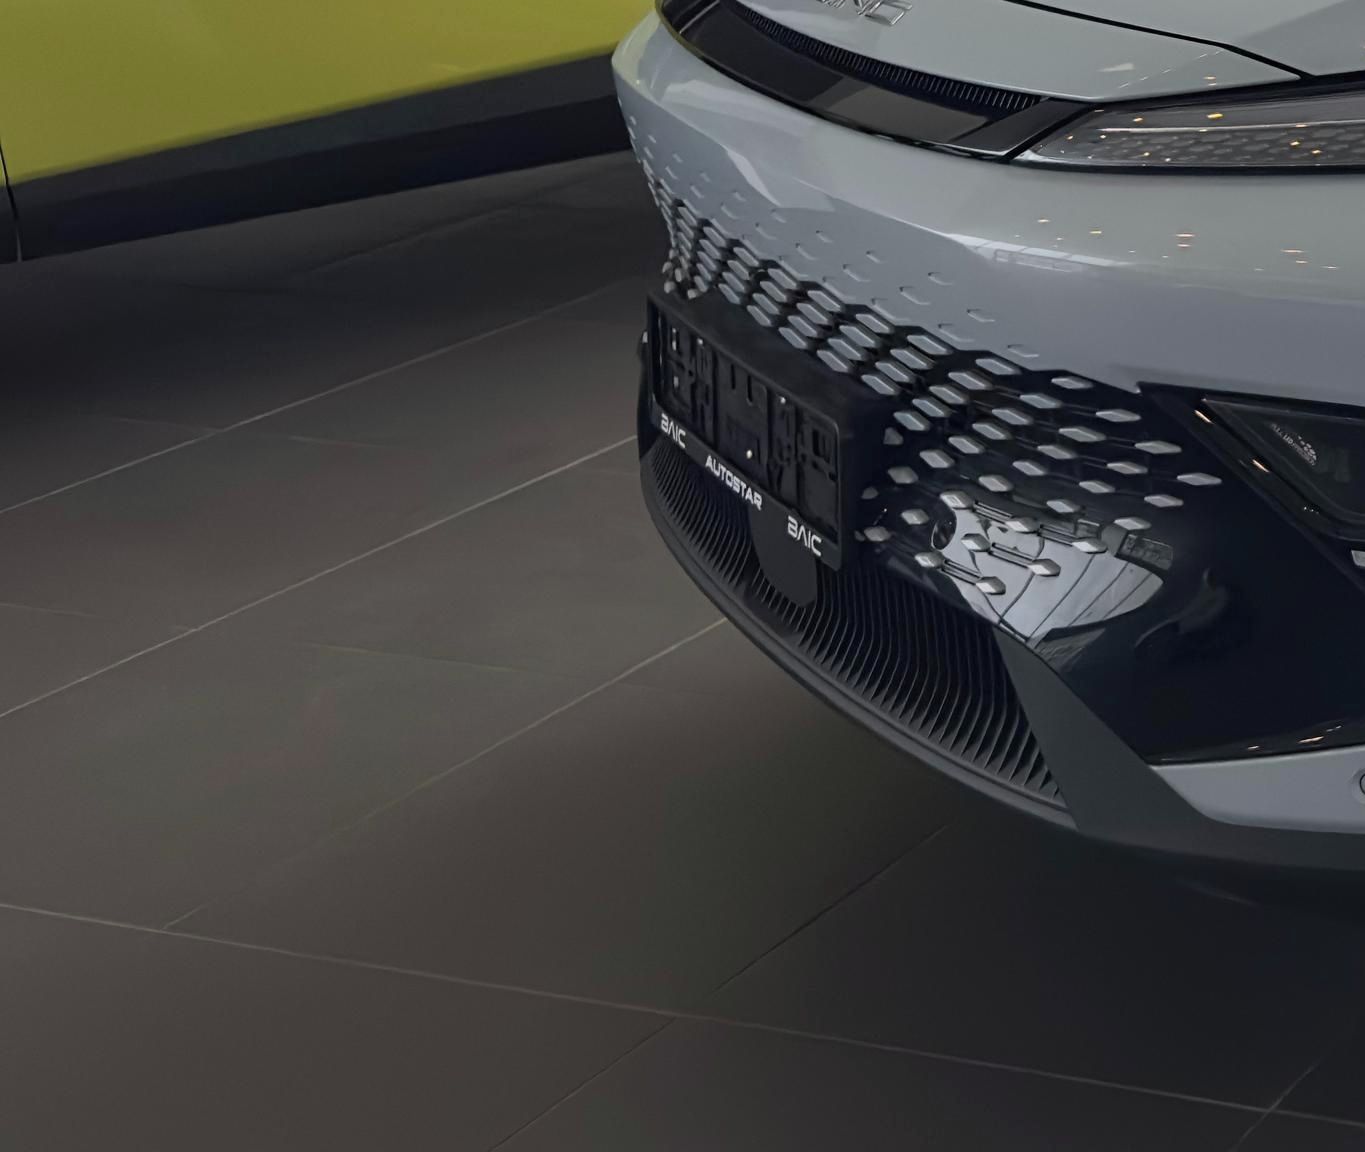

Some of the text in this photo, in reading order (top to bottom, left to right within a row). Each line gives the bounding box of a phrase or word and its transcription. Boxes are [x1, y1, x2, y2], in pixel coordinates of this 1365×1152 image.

[660, 413, 822, 557] BAIC AUTOSTAR BAIC
